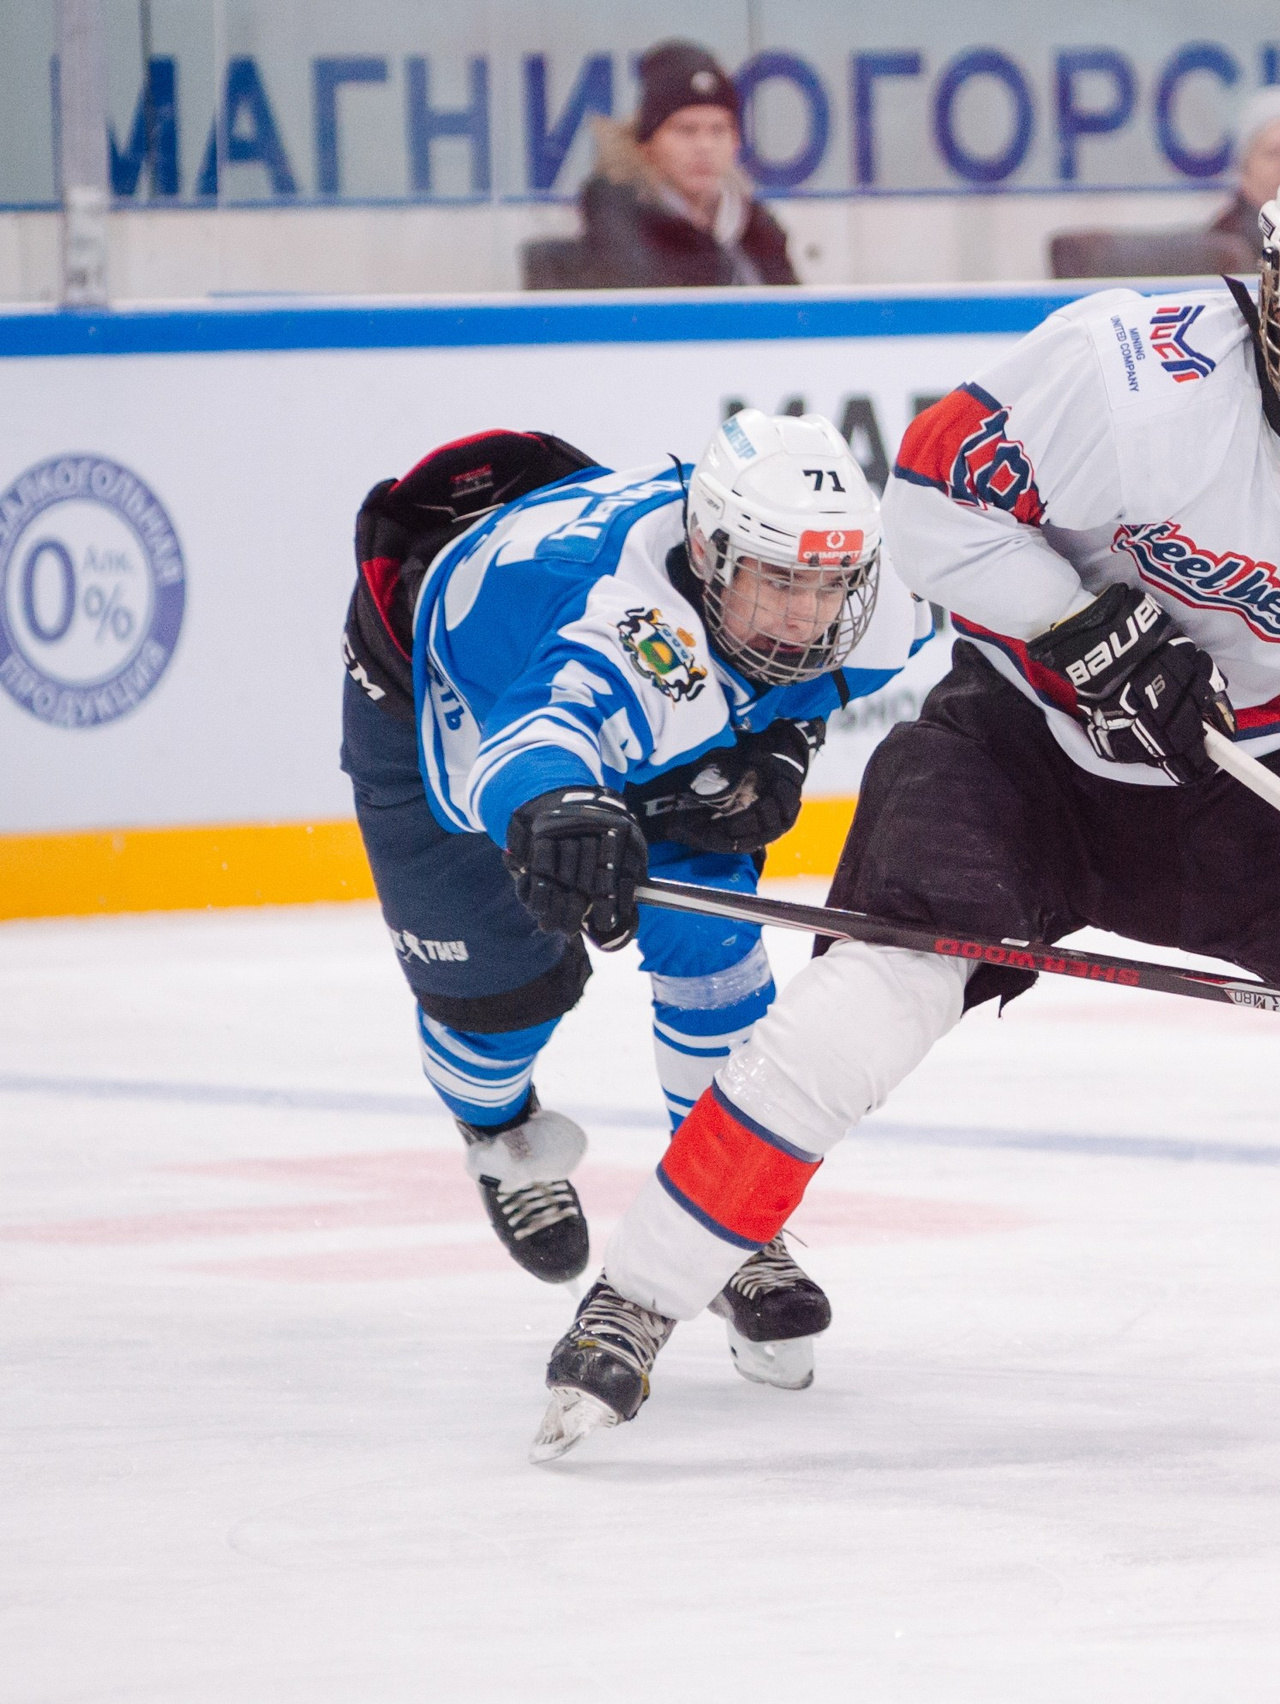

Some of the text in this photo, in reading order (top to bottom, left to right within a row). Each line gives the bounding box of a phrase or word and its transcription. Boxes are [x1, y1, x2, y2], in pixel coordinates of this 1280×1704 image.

[1110, 314, 1139, 392] UNITED COMPANY
[1129, 327, 1146, 361] MINING
[803, 468, 847, 494] 71
